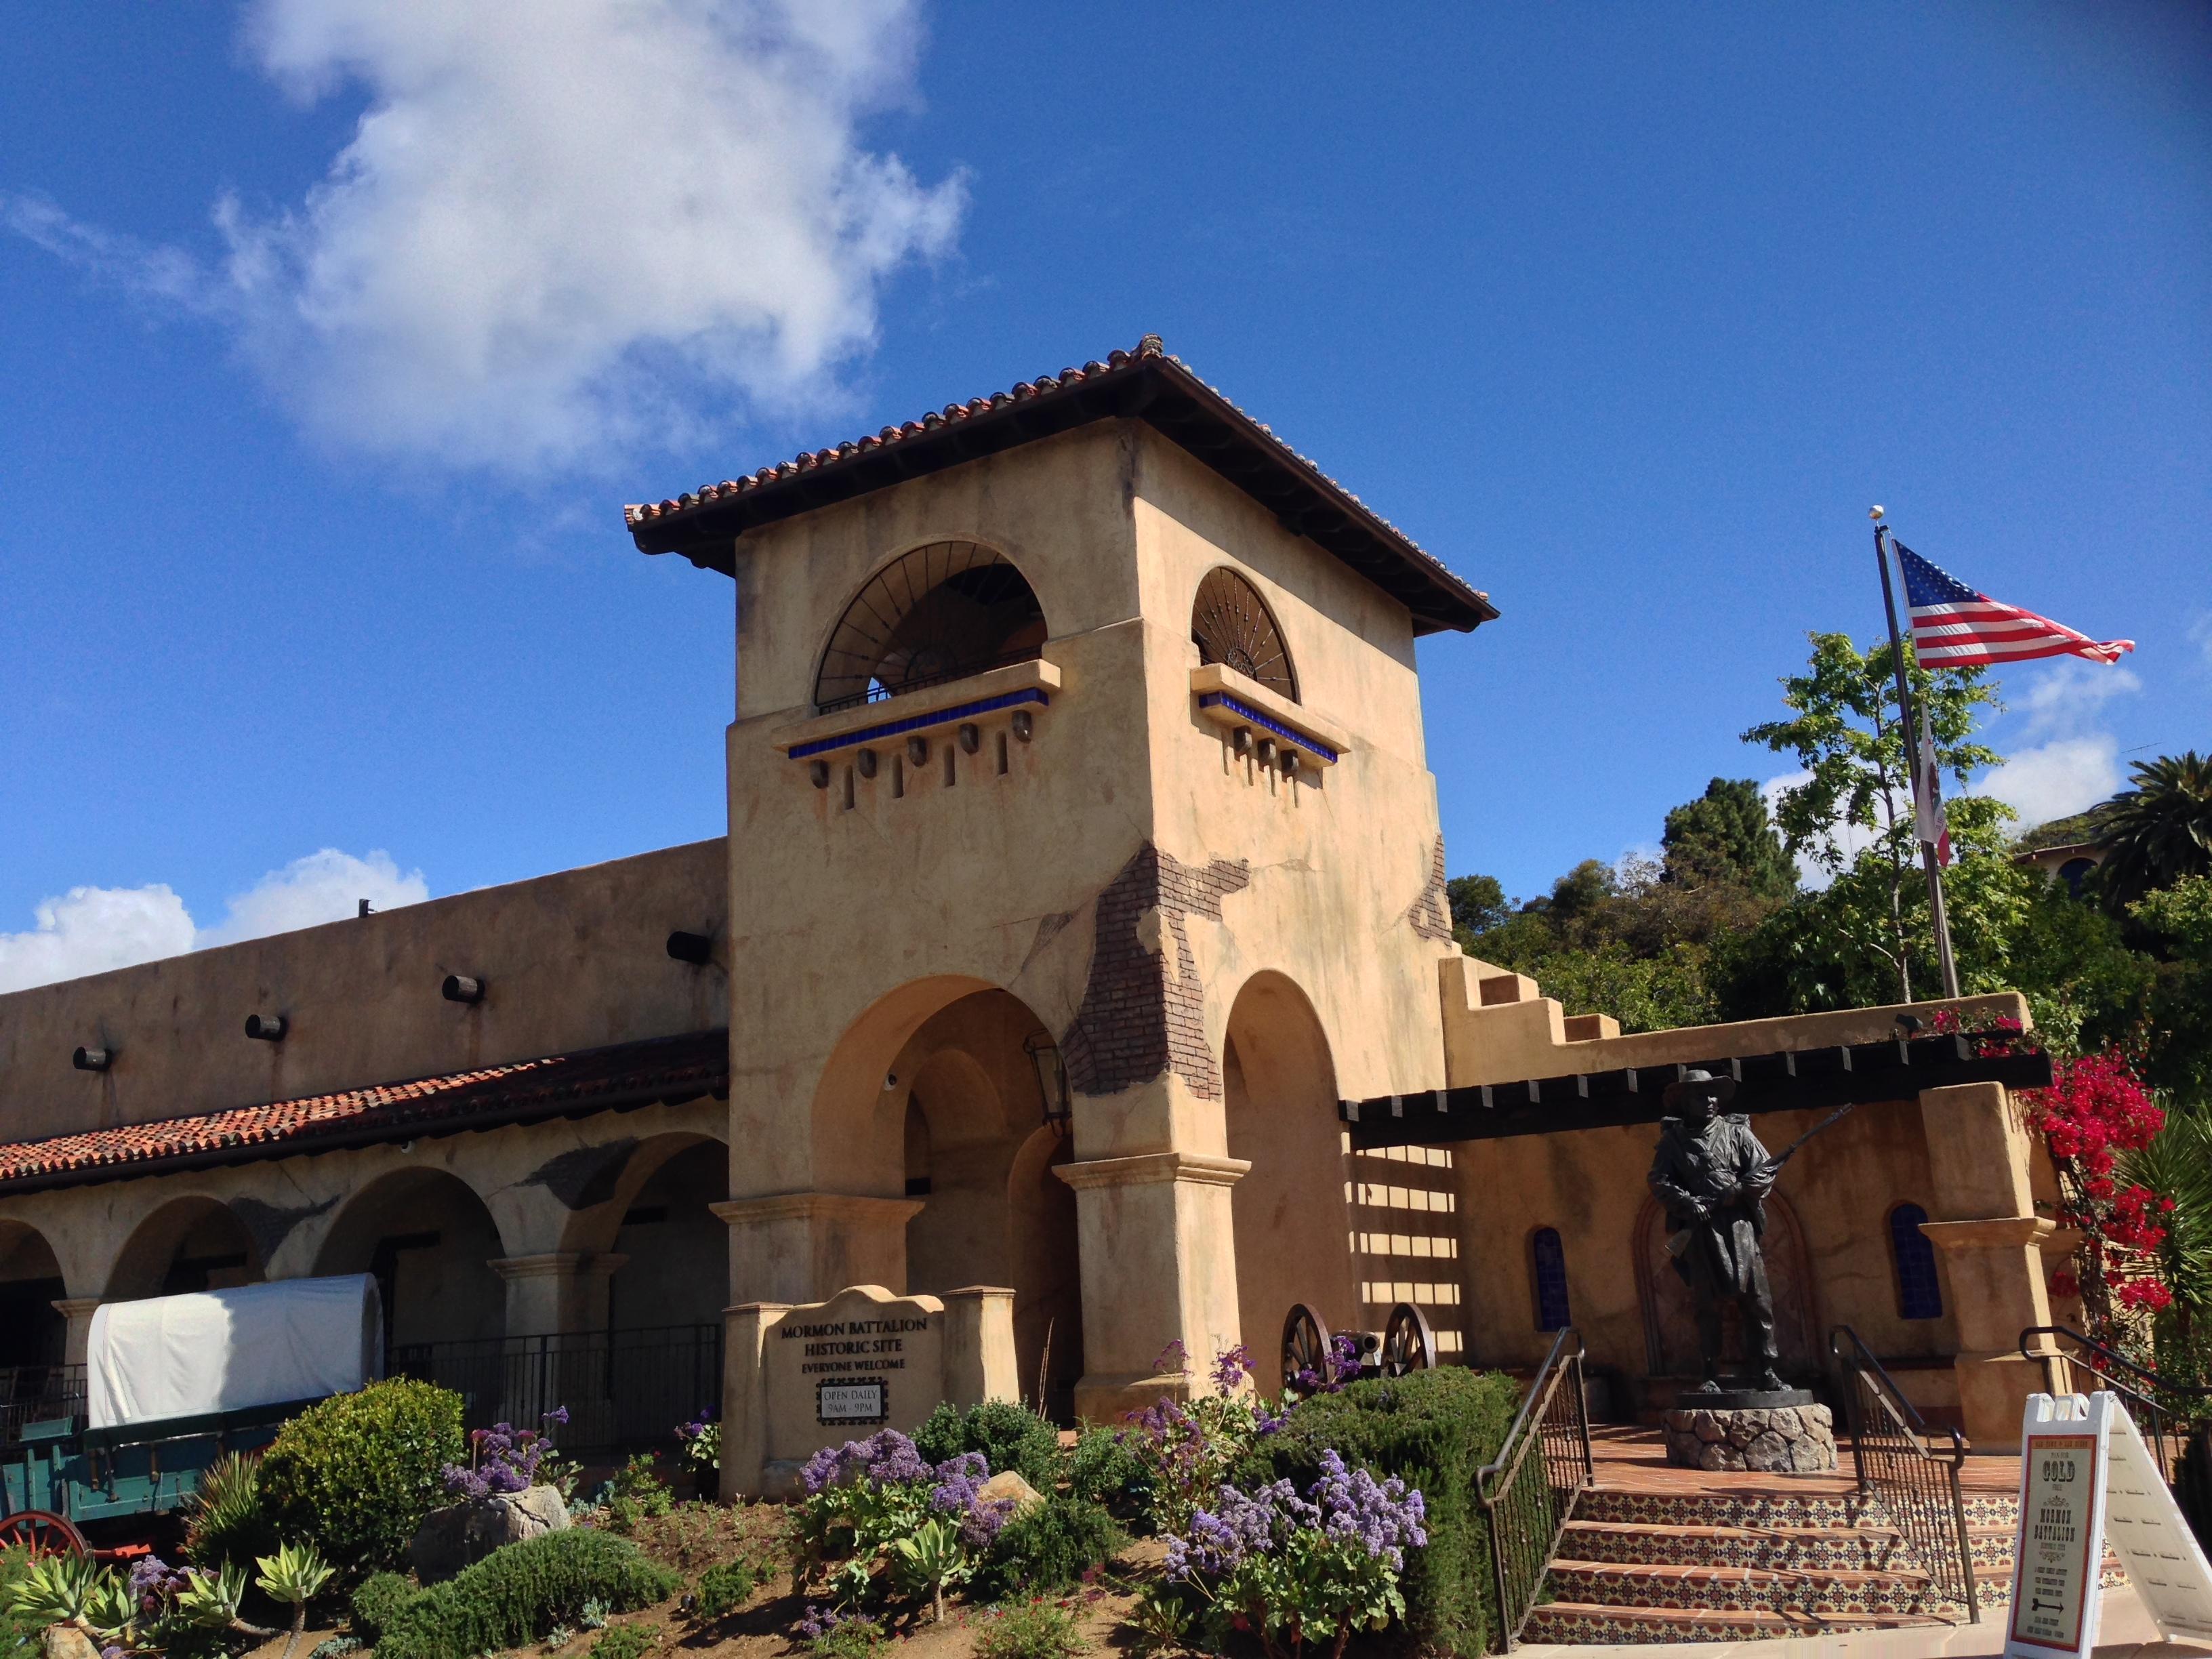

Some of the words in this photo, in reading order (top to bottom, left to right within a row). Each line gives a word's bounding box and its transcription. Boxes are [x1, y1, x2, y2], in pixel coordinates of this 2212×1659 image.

[781, 1323, 845, 1339] MORMON
[849, 1317, 927, 1334] BATTALION
[804, 1341, 869, 1356] HISTORIC
[873, 1339, 902, 1353] SITE
[802, 1361, 852, 1374] EVERYONE
[855, 1359, 905, 1370] WELCOME
[824, 1391, 848, 1400] OPEN
[851, 1390, 877, 1399] DAILY
[828, 1404, 846, 1412] 9AM
[855, 1403, 873, 1412] 9PM
[2043, 1460, 2075, 1482] GOLD
[2040, 1508, 2071, 1524] MORMON
[2034, 1525, 2075, 1542] BATTALION
